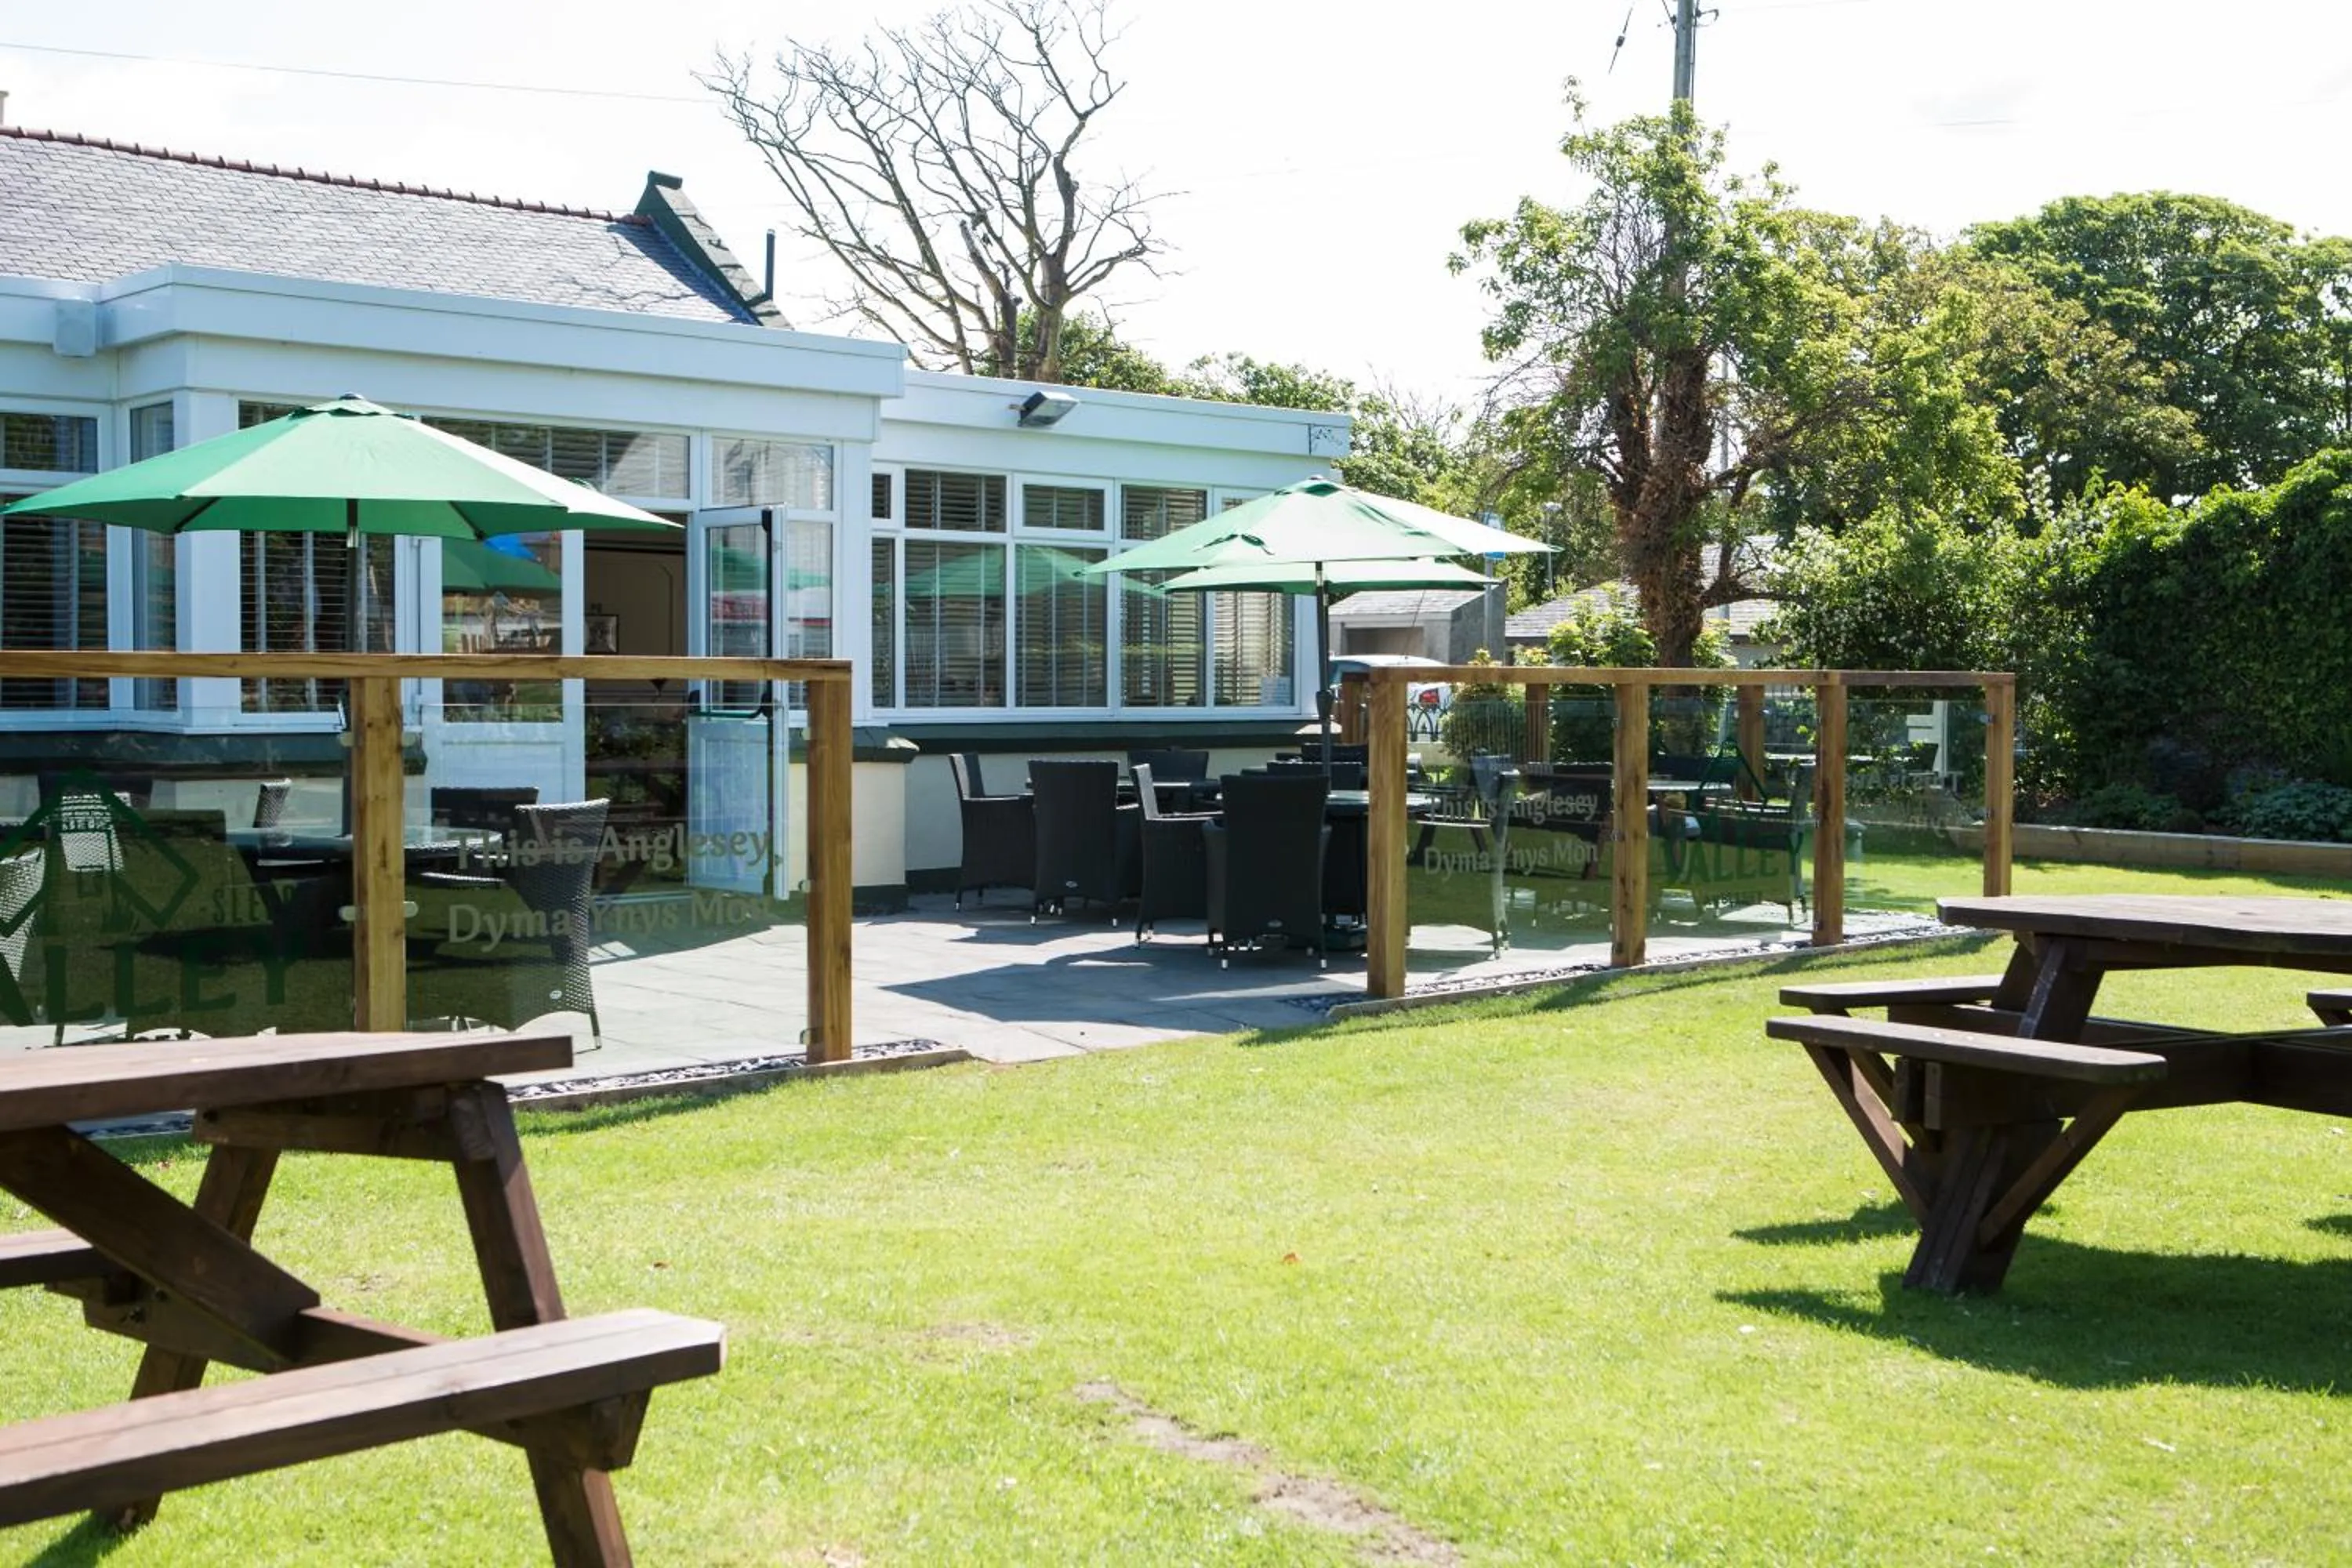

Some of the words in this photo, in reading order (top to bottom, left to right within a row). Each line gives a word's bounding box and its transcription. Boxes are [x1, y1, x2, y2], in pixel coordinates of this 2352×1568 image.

[447, 828, 541, 869] This
[550, 827, 585, 866] is
[597, 821, 770, 871] Anglesey
[1425, 847, 1489, 880] Dyma
[448, 900, 574, 953] Dyma
[587, 896, 682, 936] Ynys
